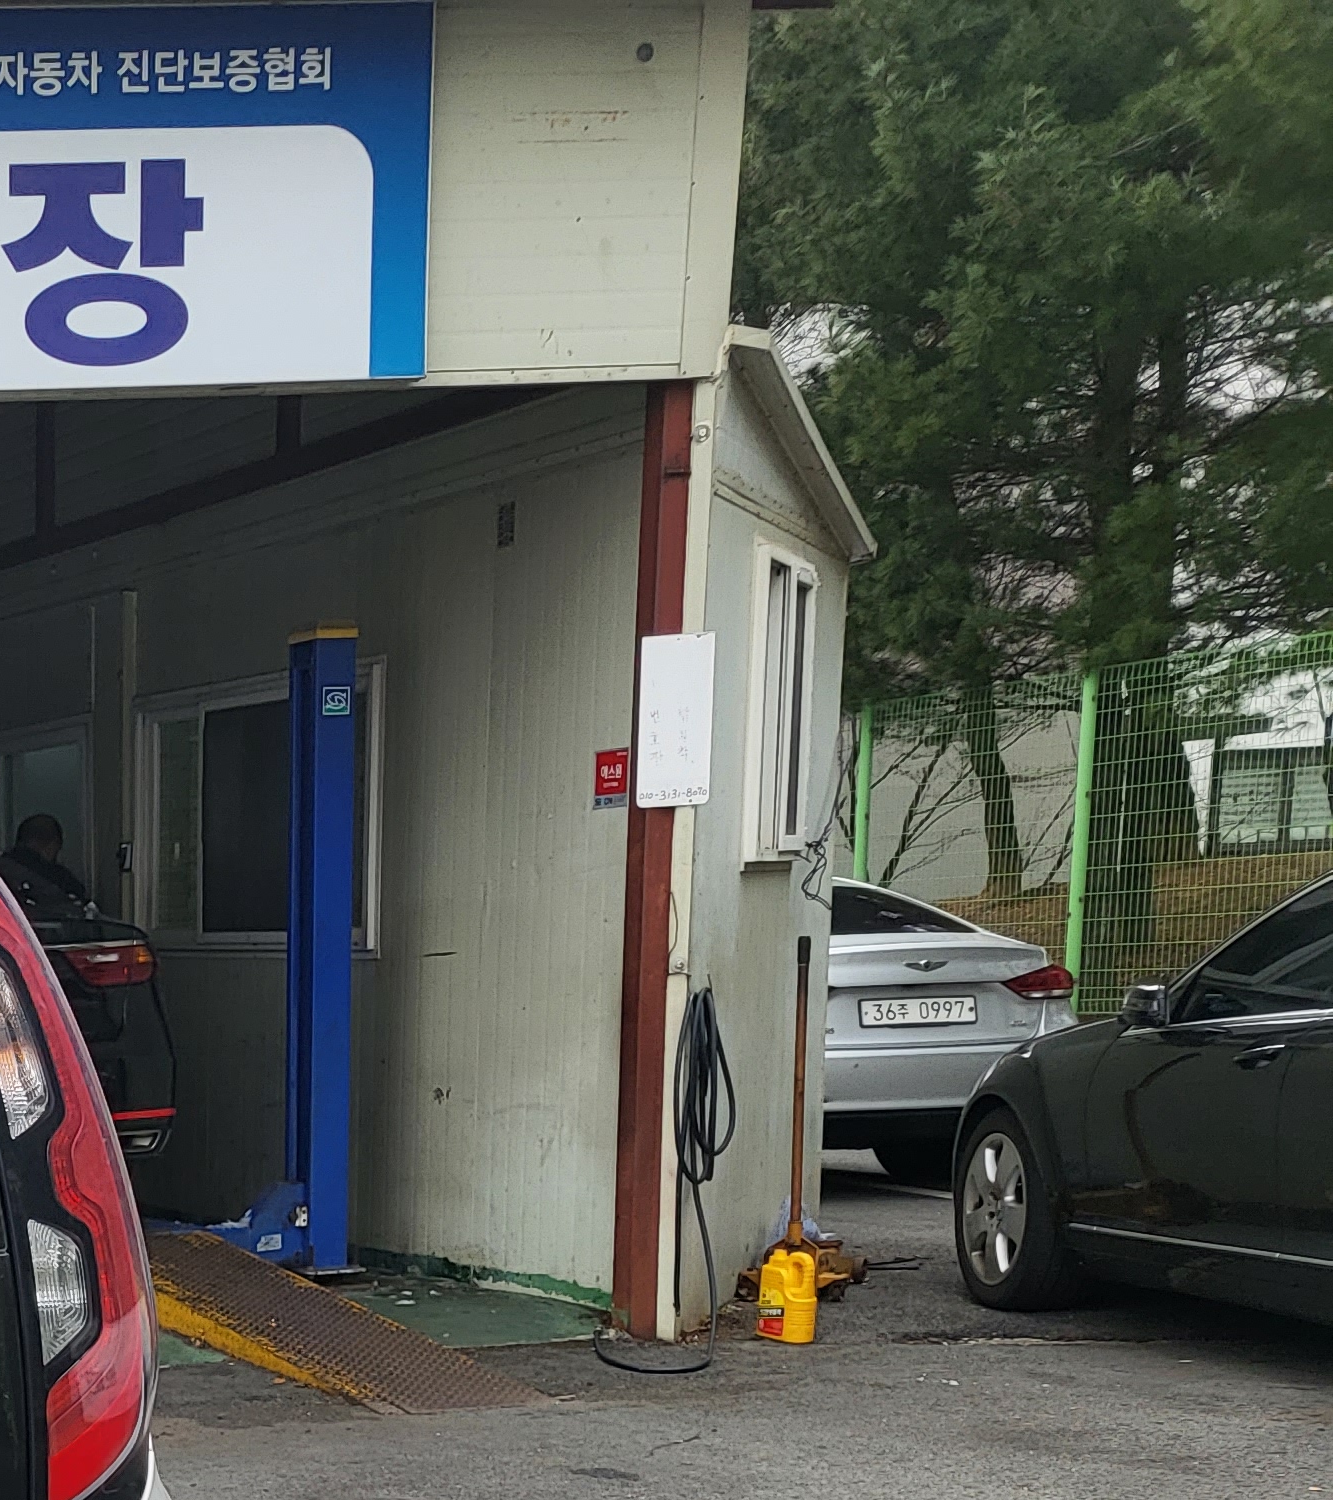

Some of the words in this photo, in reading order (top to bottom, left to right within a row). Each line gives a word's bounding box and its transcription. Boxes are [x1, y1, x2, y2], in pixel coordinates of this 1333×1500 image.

[117, 46, 332, 94] 진단보증협회
[872, 1002, 910, 1022] 36주
[918, 1000, 965, 1020] 0997
